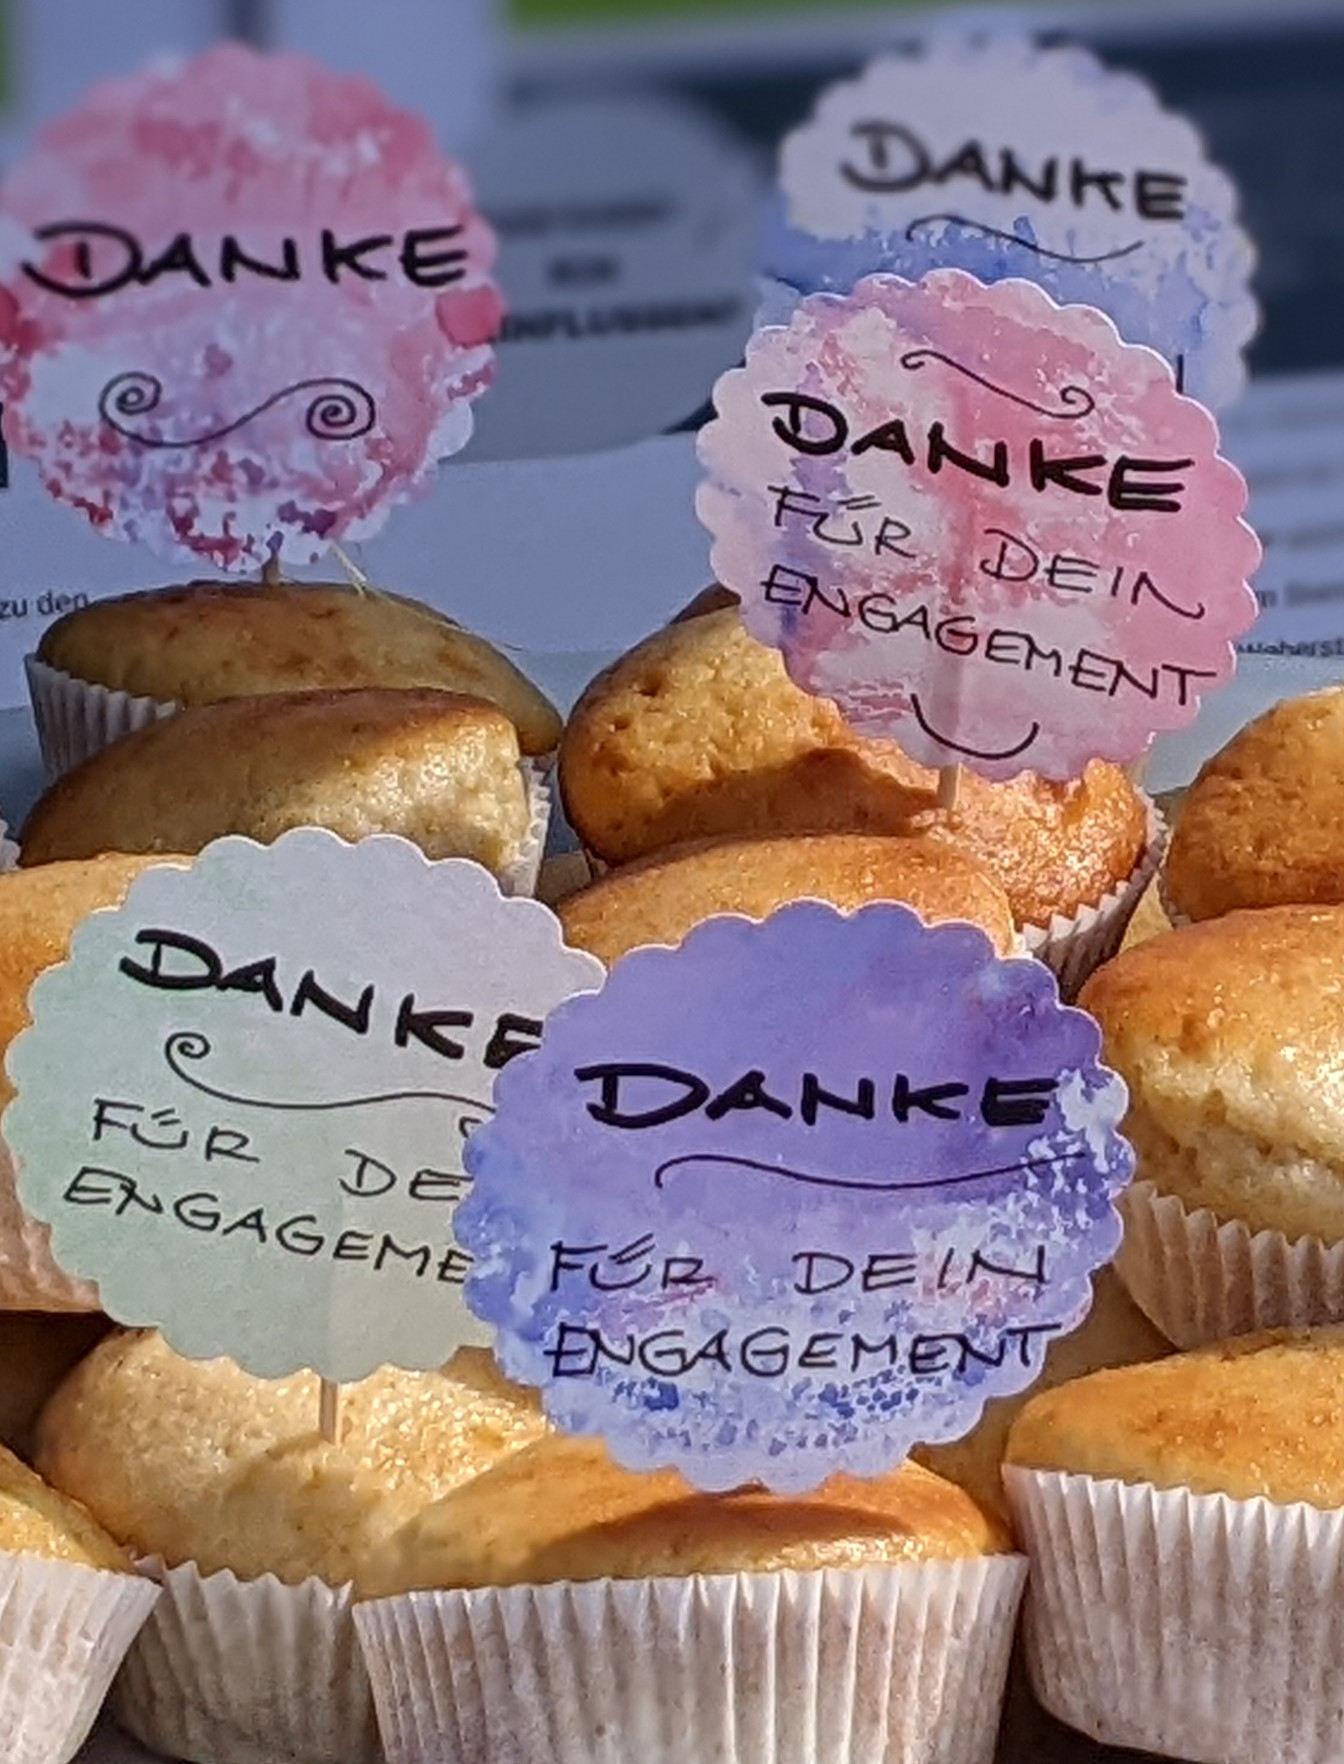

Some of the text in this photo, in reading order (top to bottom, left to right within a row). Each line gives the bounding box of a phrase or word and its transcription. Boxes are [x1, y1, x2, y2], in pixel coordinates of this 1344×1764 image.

[839, 119, 1188, 220] DANKE
[19, 220, 468, 298] DANKE
[761, 391, 1195, 513] DANKE
[767, 484, 917, 559] FÜR
[979, 528, 1205, 620] DEIN
[760, 564, 1217, 706] ENGAGEMENT
[119, 928, 545, 1069] DANKE
[574, 1062, 1060, 1130] DANKE
[92, 1098, 475, 1202] FÜR DE
[63, 1166, 475, 1285] ENGAGEME
[550, 1232, 1051, 1295] FÜR DEIN
[543, 1321, 1062, 1379] ENGAGEMENT
